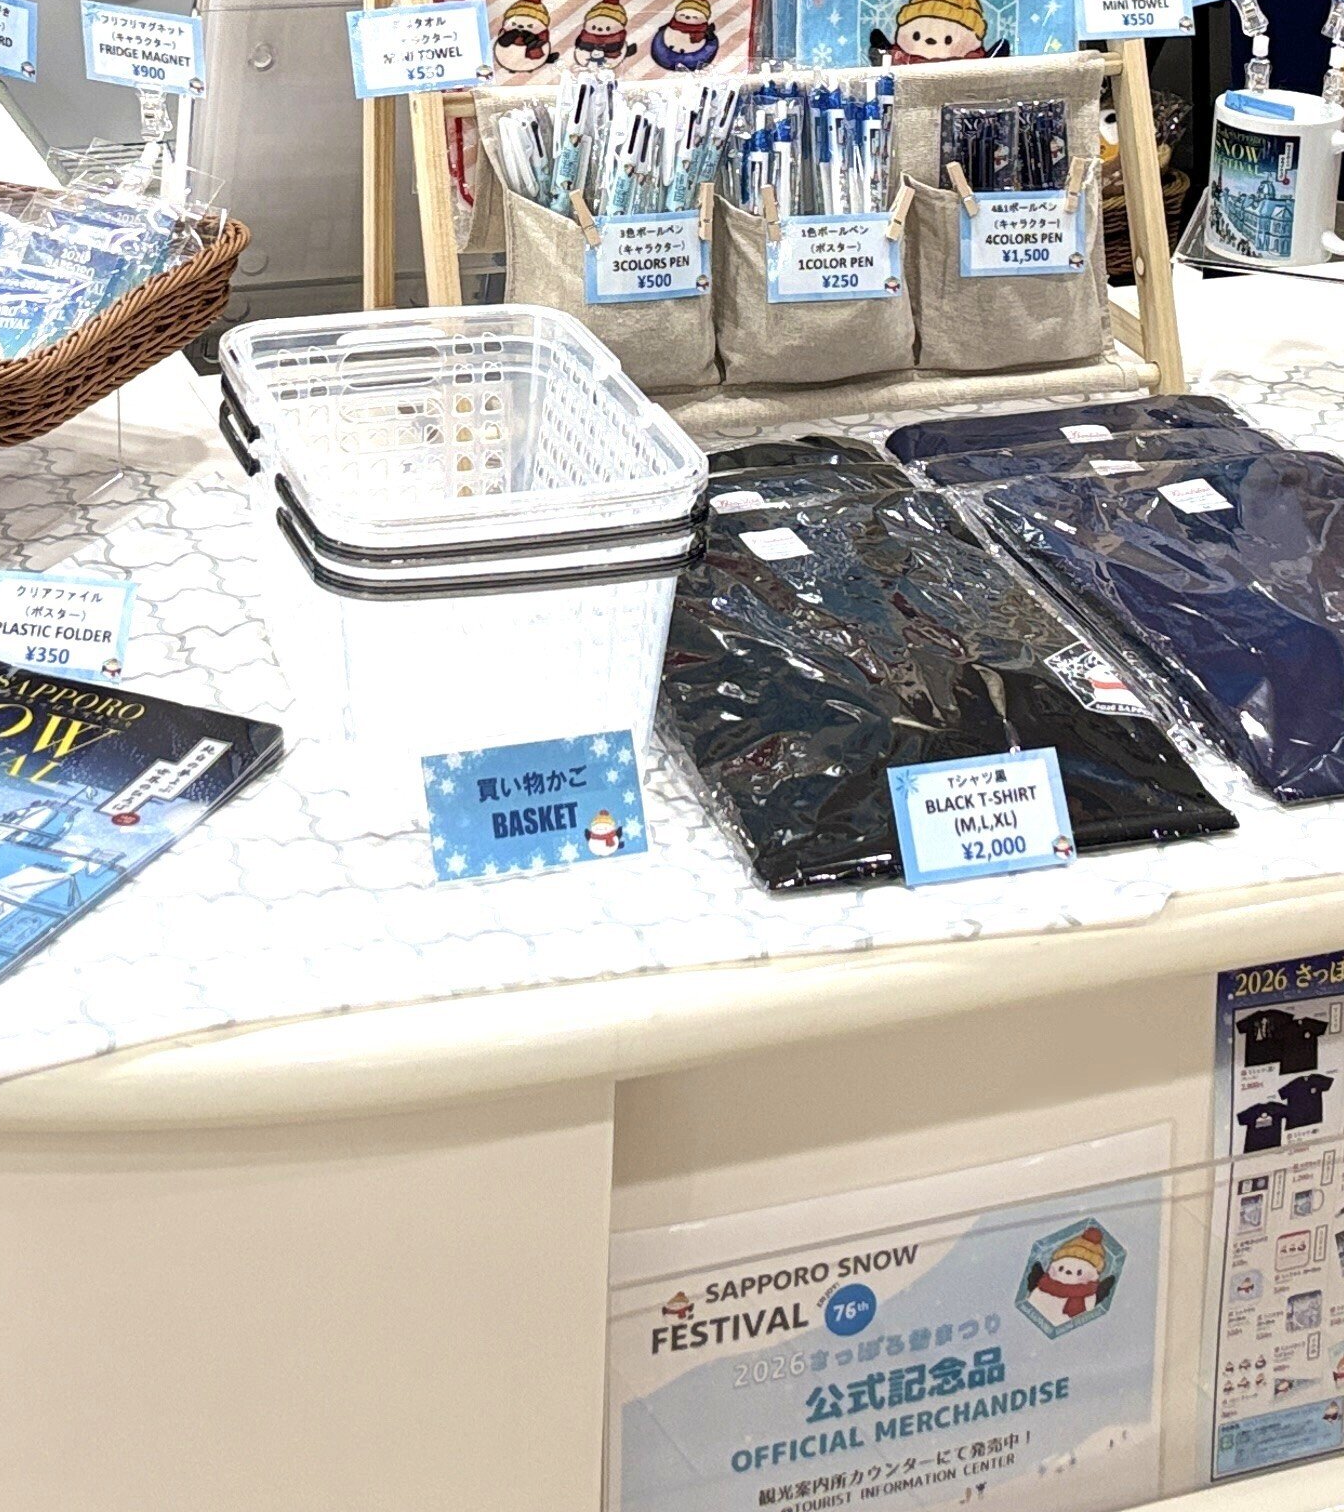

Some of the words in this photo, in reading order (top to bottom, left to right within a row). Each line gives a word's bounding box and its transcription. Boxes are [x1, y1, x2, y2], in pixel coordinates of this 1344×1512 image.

[1121, 12, 1155, 26] ¥550
[99, 42, 139, 60] FRIDGE
[141, 49, 192, 68] MAGNET
[131, 62, 166, 81] ¥900
[984, 233, 1039, 246] 4COLORS
[1040, 232, 1064, 244] PEN
[612, 257, 669, 273] 3COLORS
[670, 254, 691, 269] PEN
[798, 257, 852, 271] 1COLOR
[853, 255, 874, 269] PEN
[1001, 248, 1050, 265] ¥1,500
[636, 273, 672, 289] ¥500
[821, 273, 859, 289] ¥250
[15, 584, 104, 604] クリアファイル
[54, 625, 113, 645] FOLDER
[24, 644, 71, 666] ¥350
[924, 795, 975, 815] BLACK
[977, 785, 1038, 807] T-SHIRT
[491, 801, 579, 840] BASKET
[954, 810, 1018, 837] (M,L,XL)
[961, 835, 1027, 862] ¥2,000
[1234, 967, 1288, 996] 2026
[704, 1261, 830, 1305] SAPPORO
[835, 1244, 919, 1278] SNOW
[832, 1299, 871, 1323] 76th
[651, 1301, 810, 1356] FESTIVAL
[804, 1345, 1007, 1424] 公式記念品
[731, 1427, 866, 1474] OFFICIAL
[874, 1376, 1071, 1443] MERCHANDISE
[860, 1467, 957, 1501] INFORMATION
[962, 1452, 1016, 1477] CENTER
